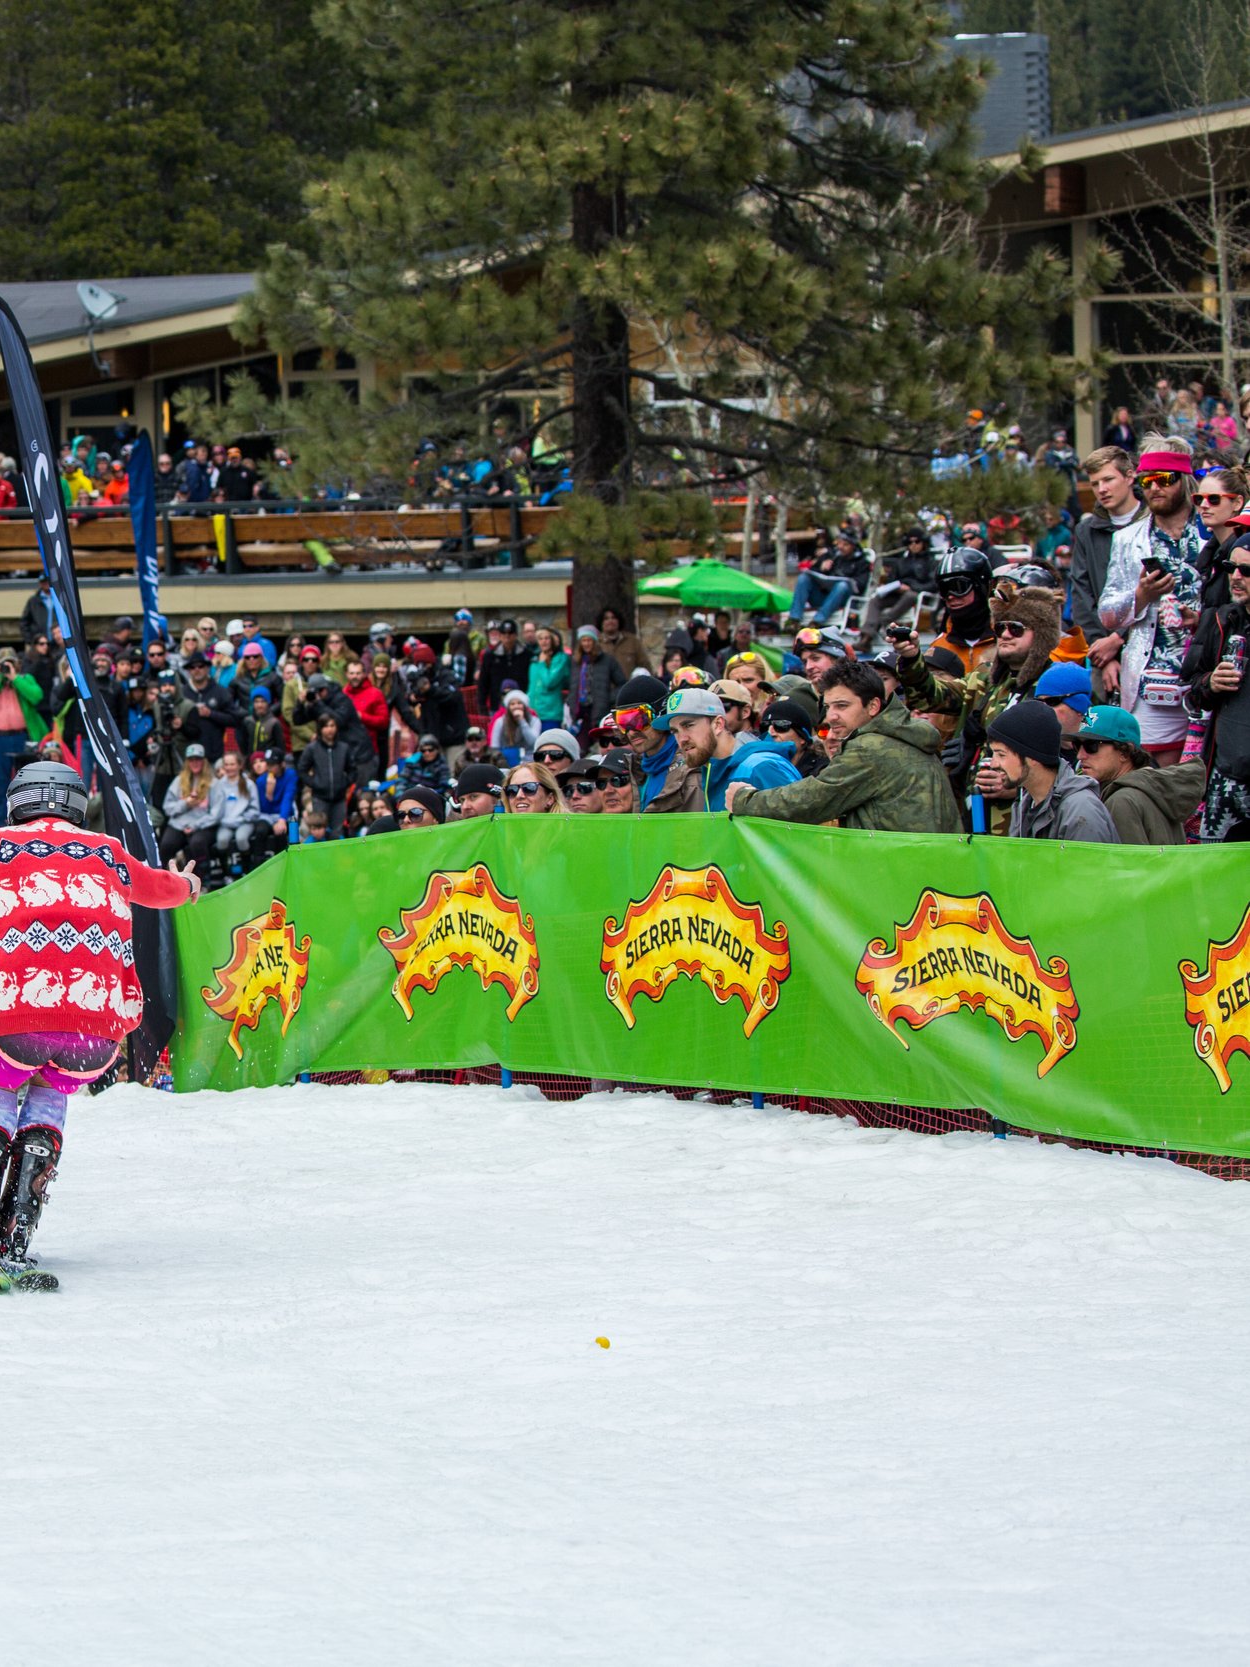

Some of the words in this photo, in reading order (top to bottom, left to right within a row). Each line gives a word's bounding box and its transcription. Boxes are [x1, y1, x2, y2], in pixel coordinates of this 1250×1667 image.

[457, 908, 519, 964] NEVADA
[625, 917, 684, 970] SIERRA
[686, 913, 755, 975] NEVADA
[890, 946, 963, 994] SIERRA
[960, 944, 1043, 1012] NEVADA
[1217, 971, 1250, 1024] SIE
